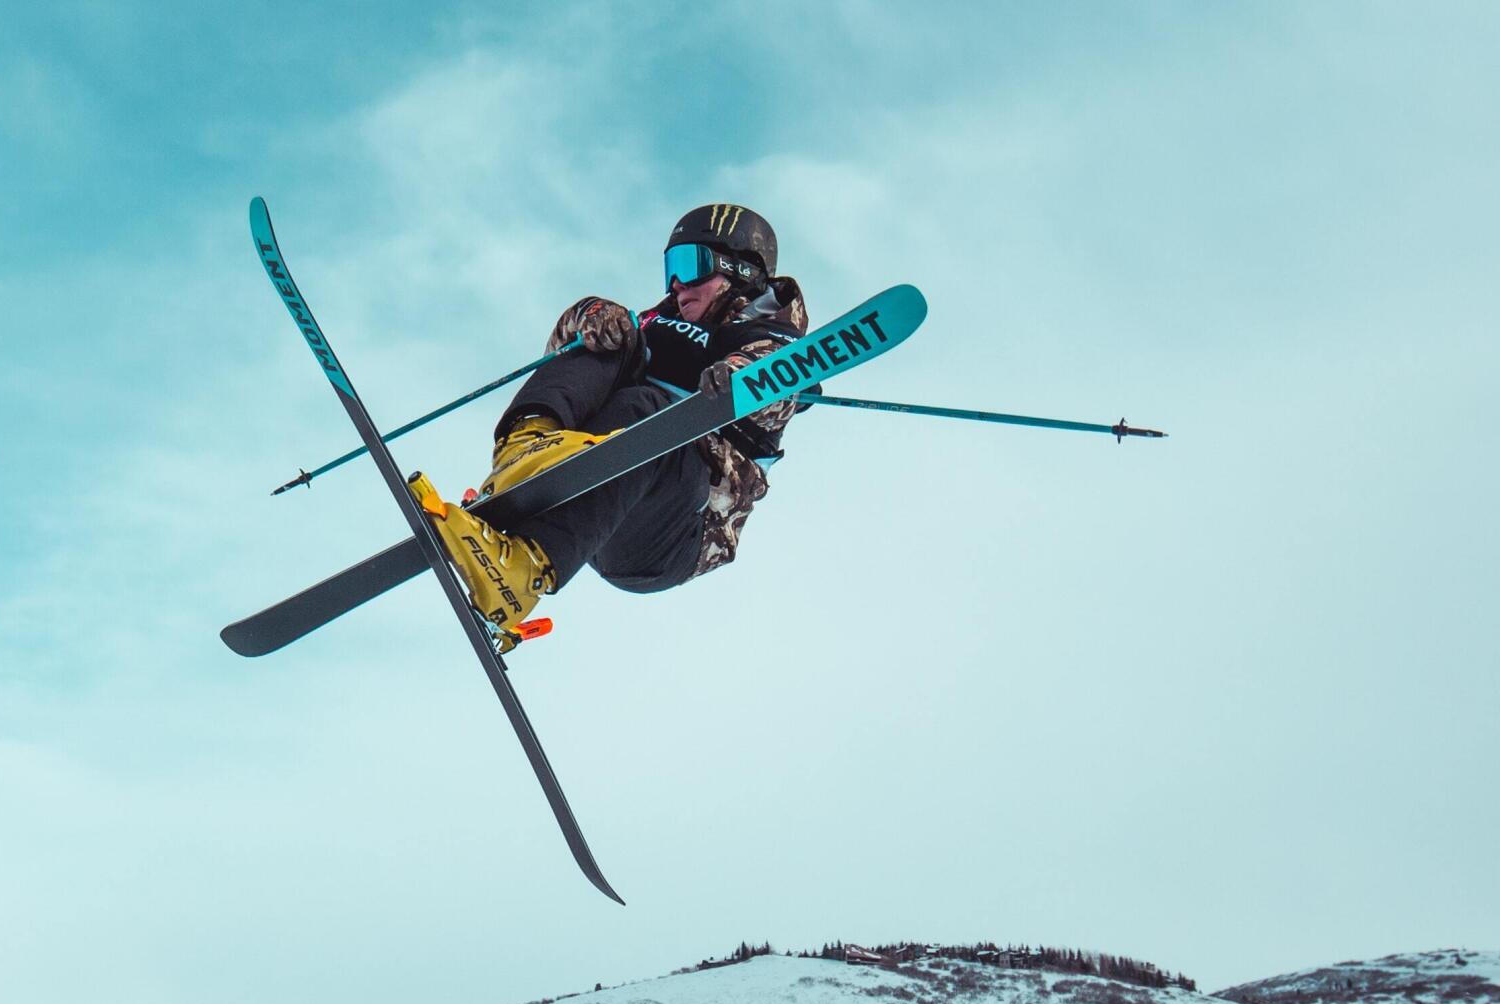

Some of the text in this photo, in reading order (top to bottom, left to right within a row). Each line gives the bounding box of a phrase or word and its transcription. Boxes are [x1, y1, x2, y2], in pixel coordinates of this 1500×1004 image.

[257, 237, 339, 372] MOMENT
[742, 311, 888, 402] MOMENT
[461, 535, 523, 614] FISCHER
